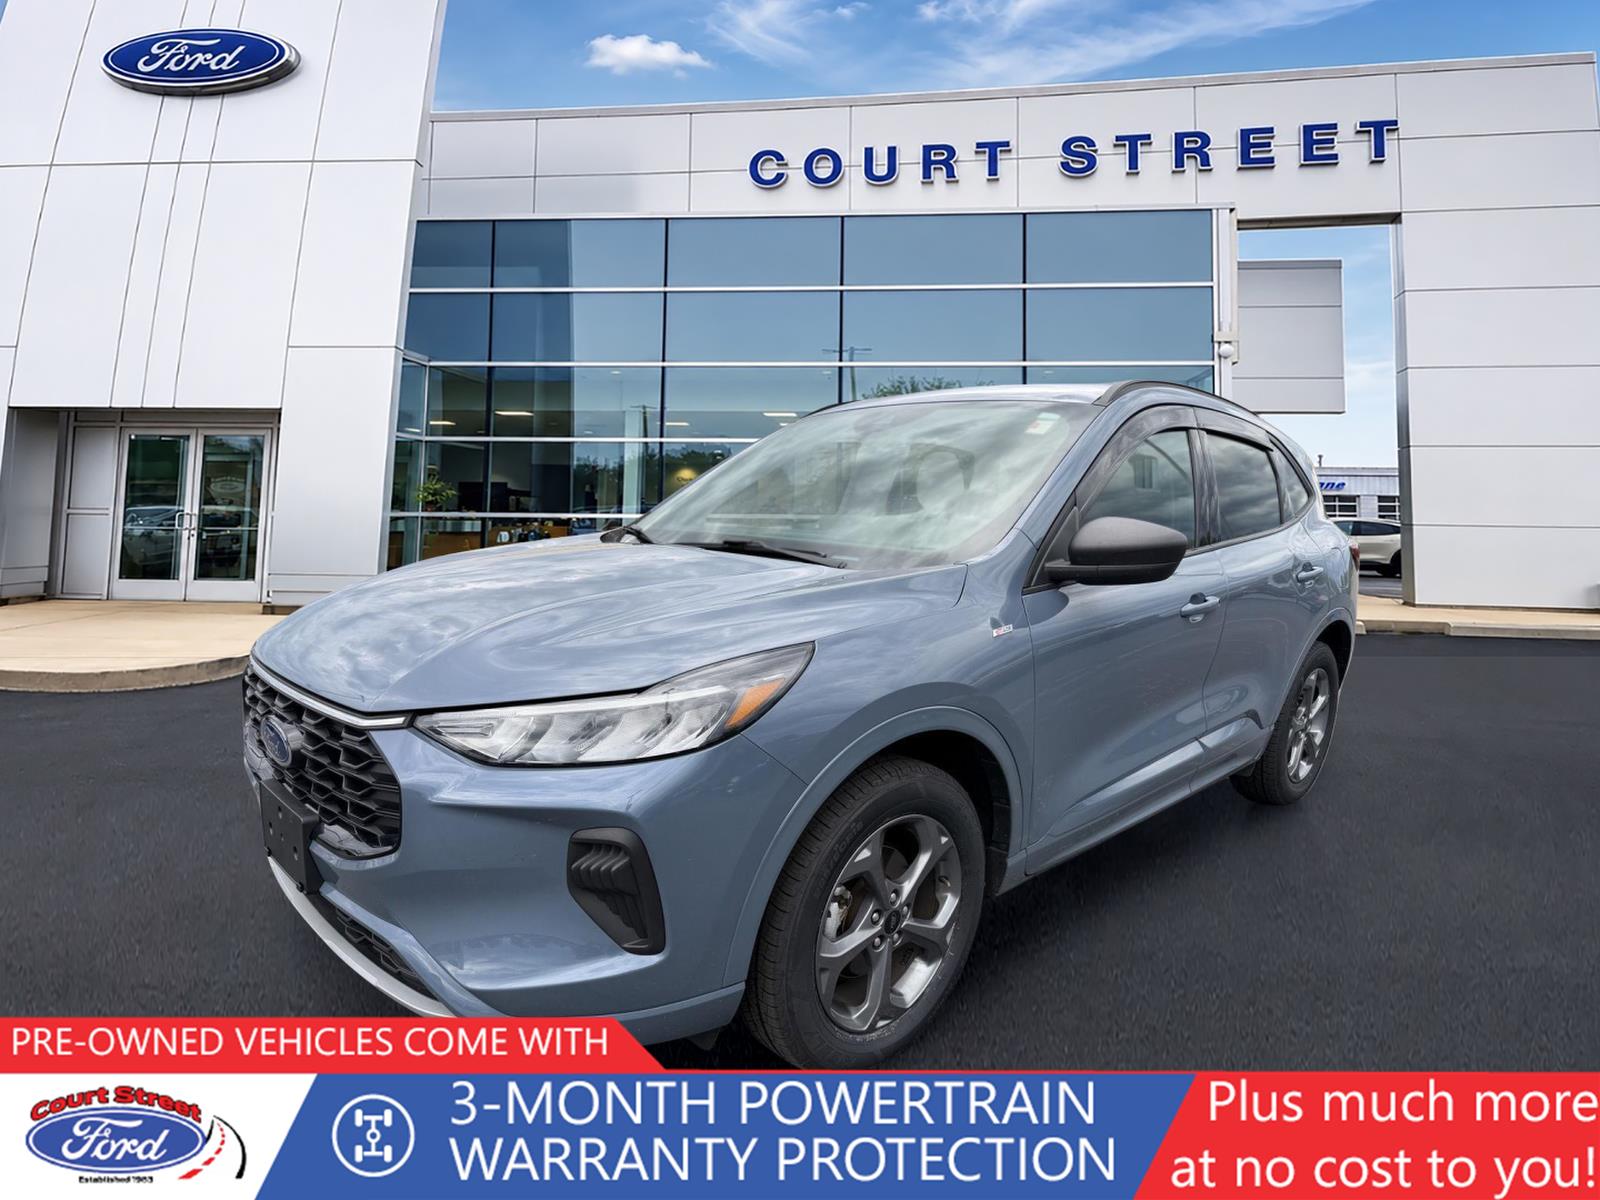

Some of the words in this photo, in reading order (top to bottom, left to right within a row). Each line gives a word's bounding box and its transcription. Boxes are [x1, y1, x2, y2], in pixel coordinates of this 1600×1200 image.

[137, 37, 246, 72] Ford
[749, 143, 1010, 188] COURT
[1060, 119, 1399, 177] STREET
